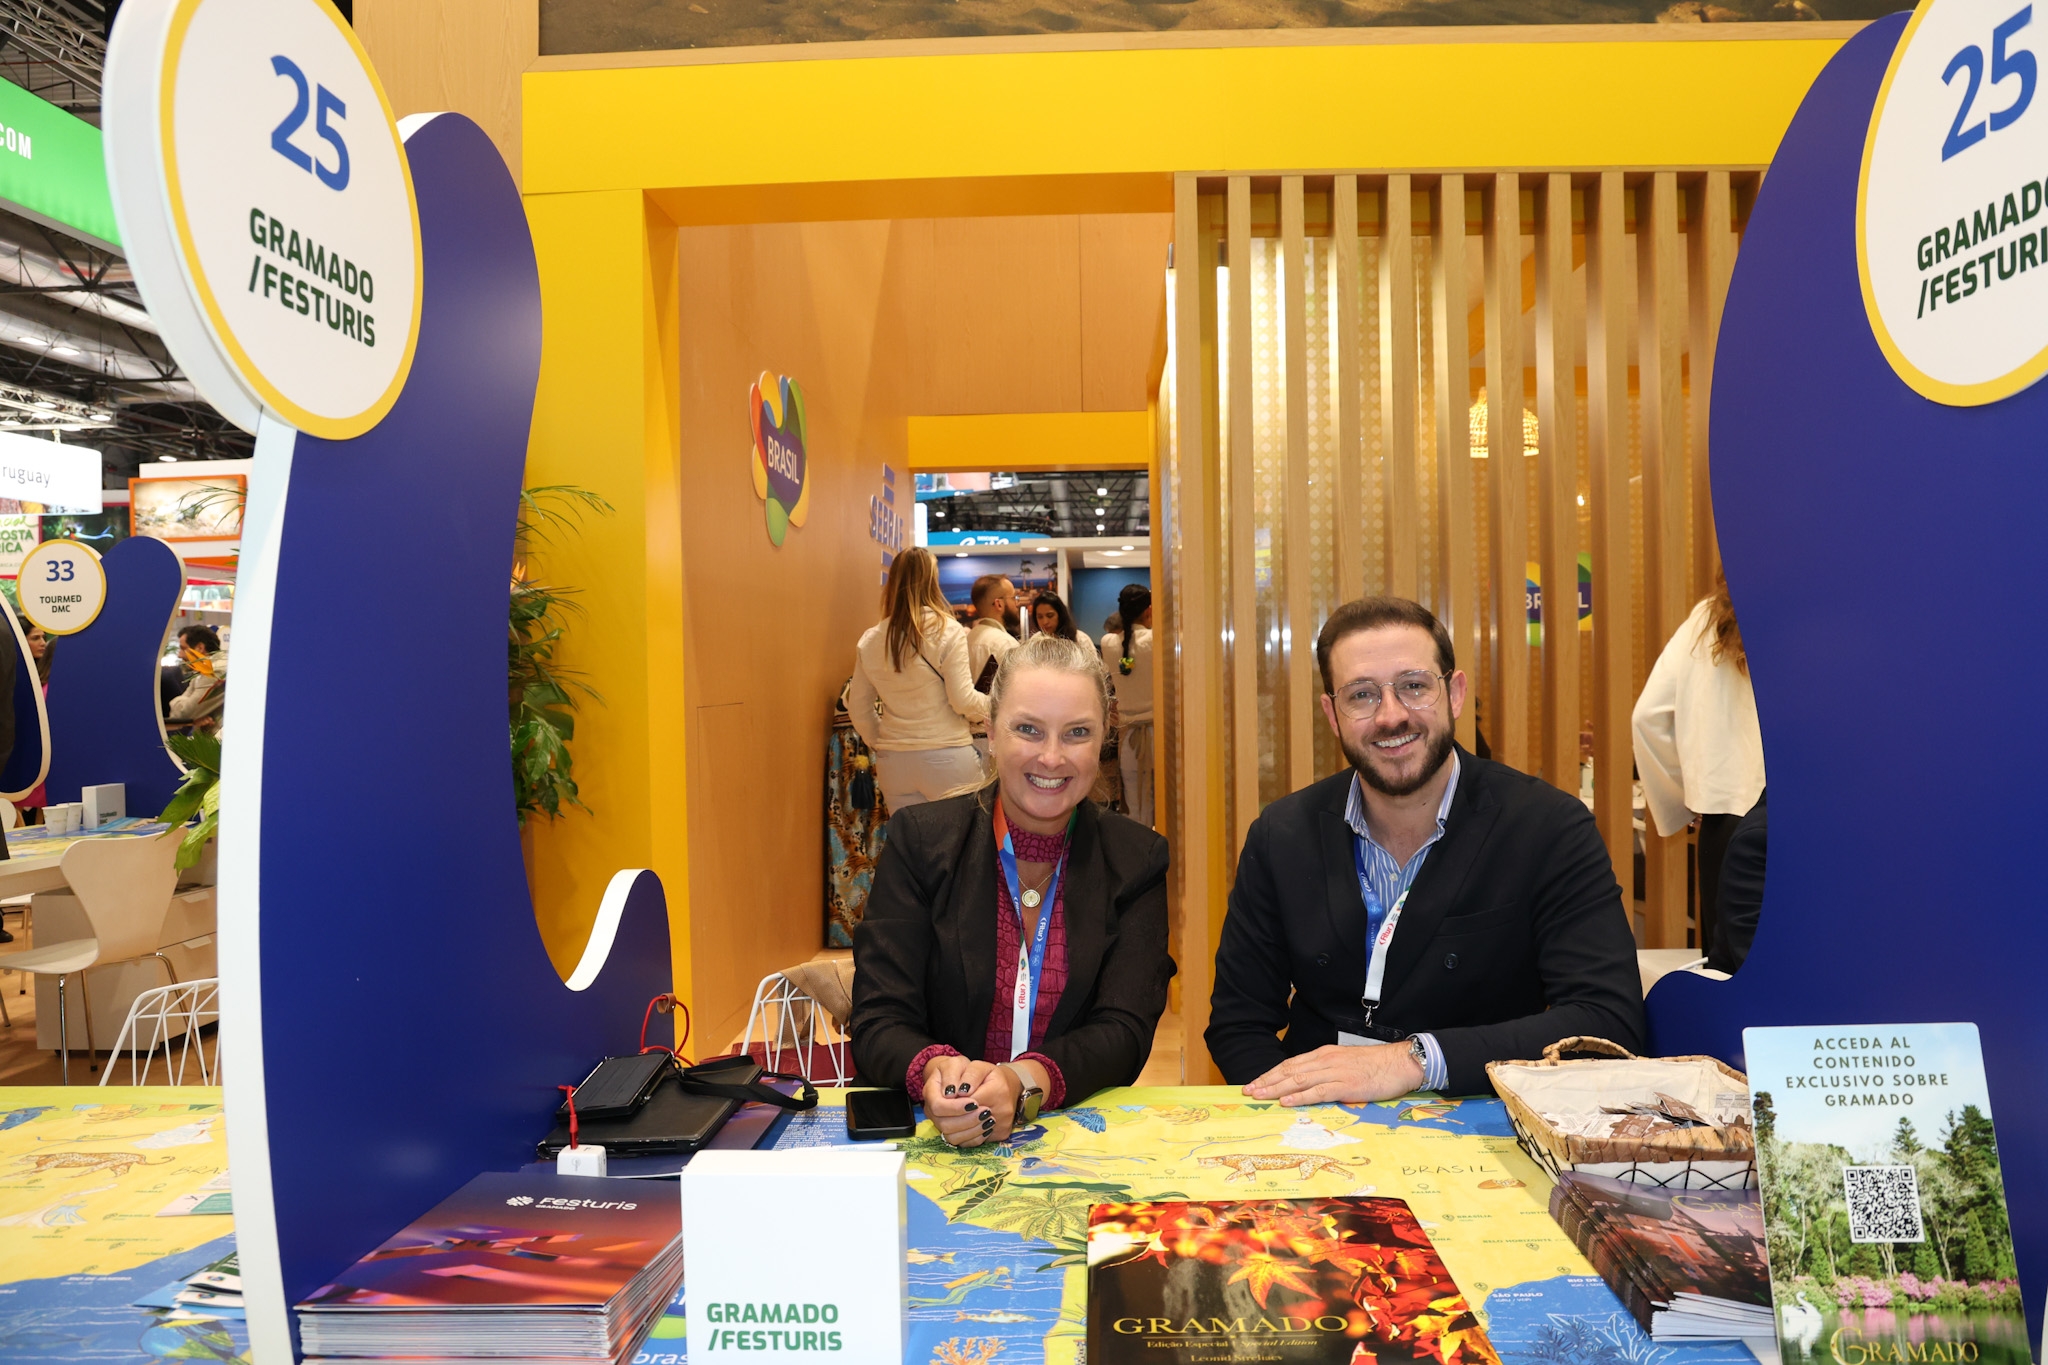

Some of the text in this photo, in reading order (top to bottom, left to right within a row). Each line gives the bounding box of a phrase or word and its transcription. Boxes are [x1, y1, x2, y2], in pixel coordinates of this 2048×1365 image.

[1942, 4, 2037, 162] 25
[270, 55, 350, 191] 25
[1917, 175, 2048, 271] GRAMAD
[250, 208, 373, 303] GRAMADO
[249, 256, 375, 347] /FESTURIS
[767, 435, 800, 485] BRASIL
[46, 560, 75, 582] 33
[39, 595, 82, 604] TOURMED
[51, 604, 71, 613] DMC
[1813, 1036, 1911, 1050] ACCEDA AL
[1813, 1055, 1916, 1069] CONTENIDO
[1786, 1073, 1949, 1088] EXCLUSIVO SOBRE
[1825, 1093, 1914, 1107] GRAMADO
[1402, 1165, 1497, 1175] BRASIL
[539, 1197, 638, 1211] Festuris
[707, 1303, 838, 1323] GRAMADO
[1113, 1316, 1349, 1334] GRAMADO
[708, 1330, 842, 1351] /FESTURIS
[1147, 1340, 1183, 1348] Edição
[1185, 1340, 1228, 1348] Especial
[1830, 1327, 1979, 1365] GRAMADO
